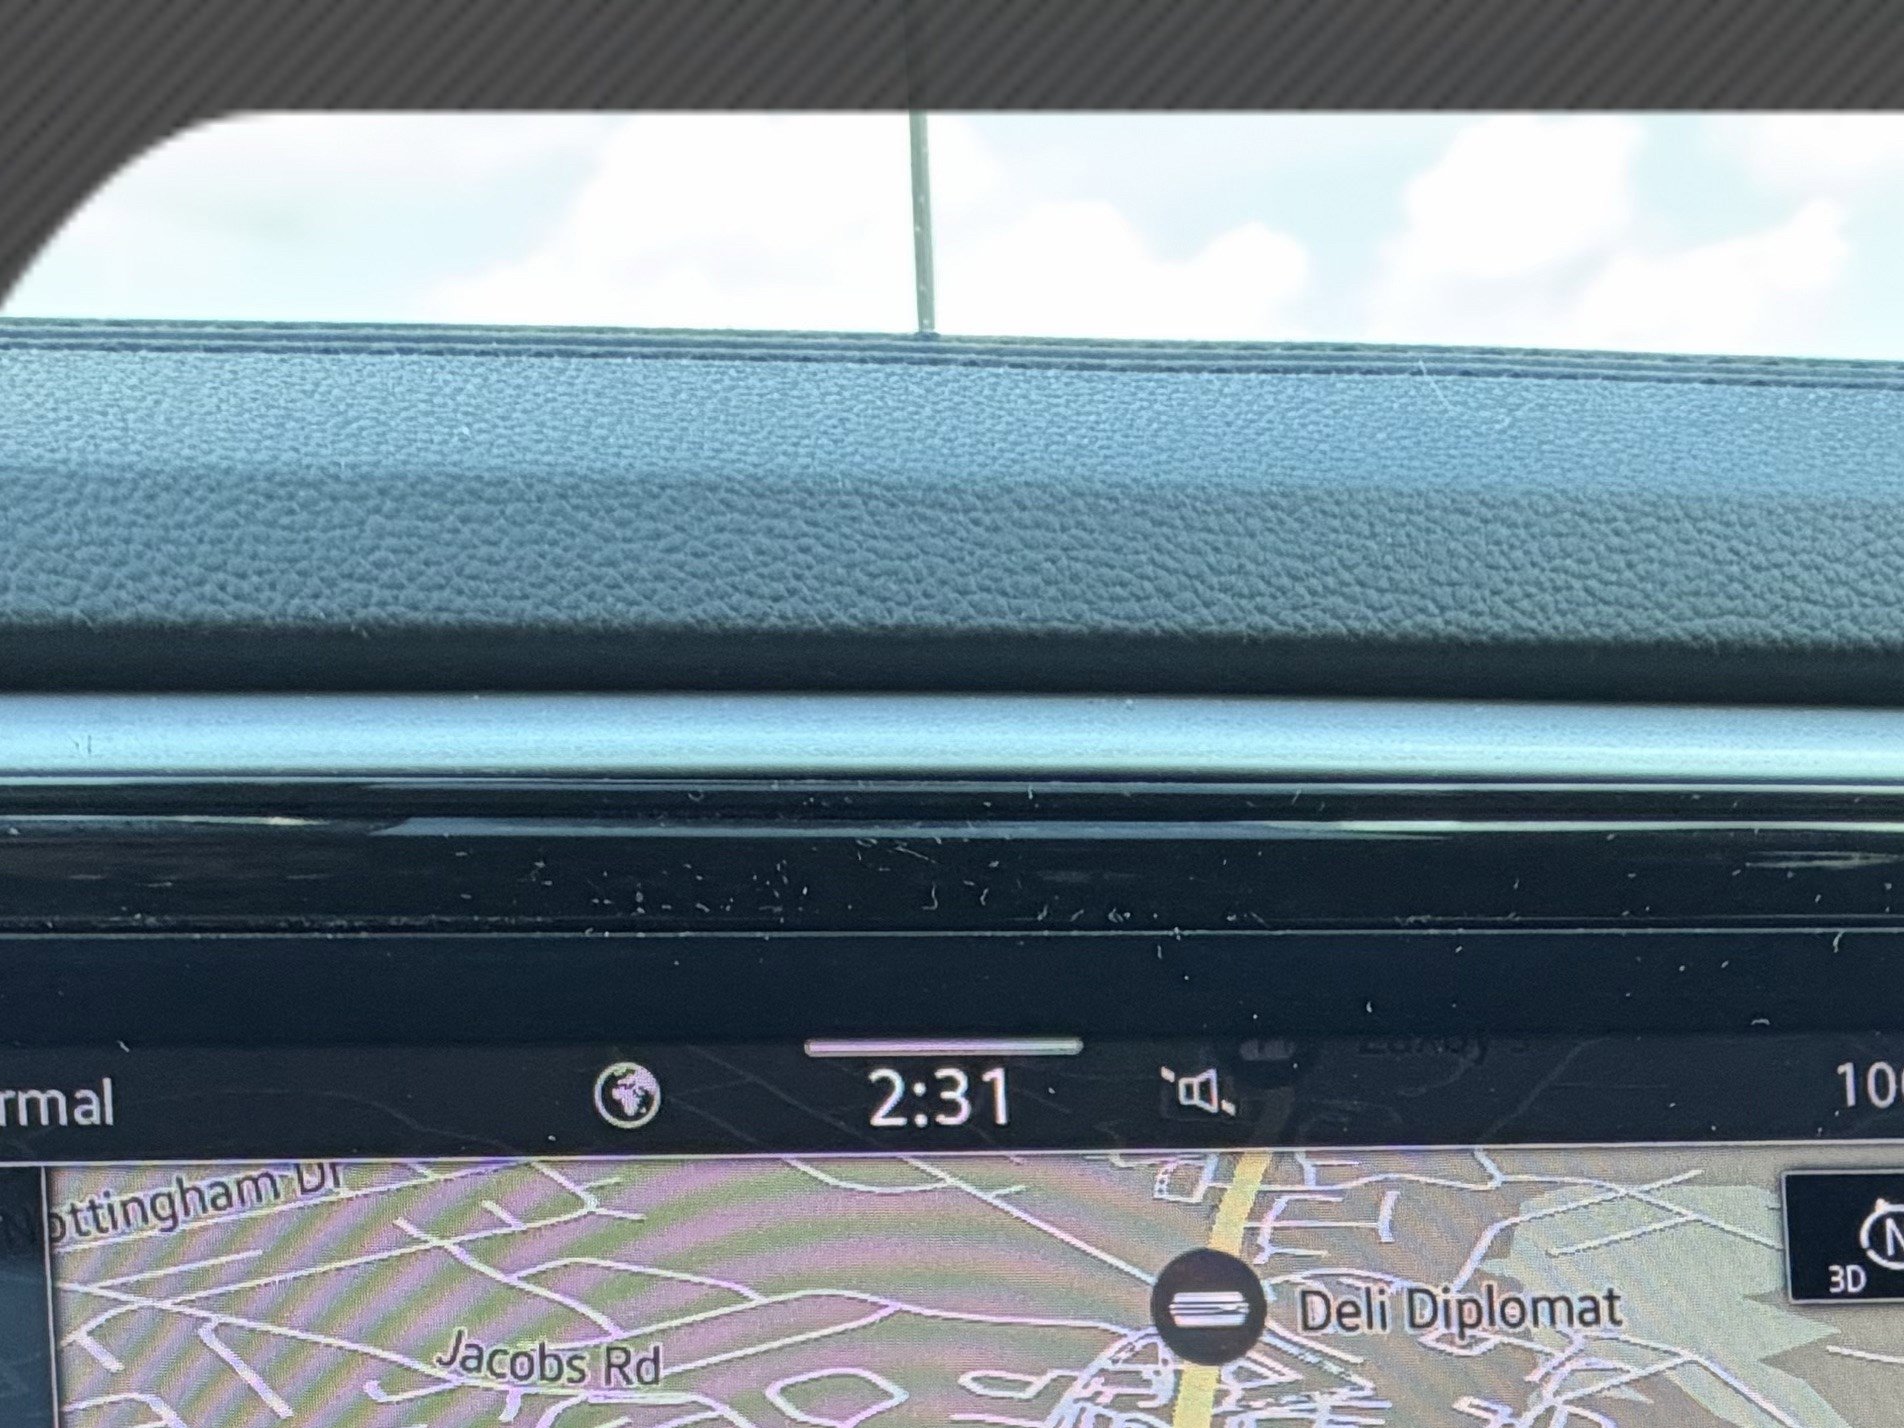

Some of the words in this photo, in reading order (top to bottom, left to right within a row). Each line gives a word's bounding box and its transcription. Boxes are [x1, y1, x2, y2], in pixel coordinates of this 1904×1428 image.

[868, 1066, 1010, 1128] 2:31
[1827, 1264, 1868, 1294] 3D
[1299, 1284, 1389, 1332] Deli
[1407, 1282, 1623, 1341] Diplomat
[436, 1327, 587, 1384] Jacobs
[604, 1344, 662, 1387] Rd
